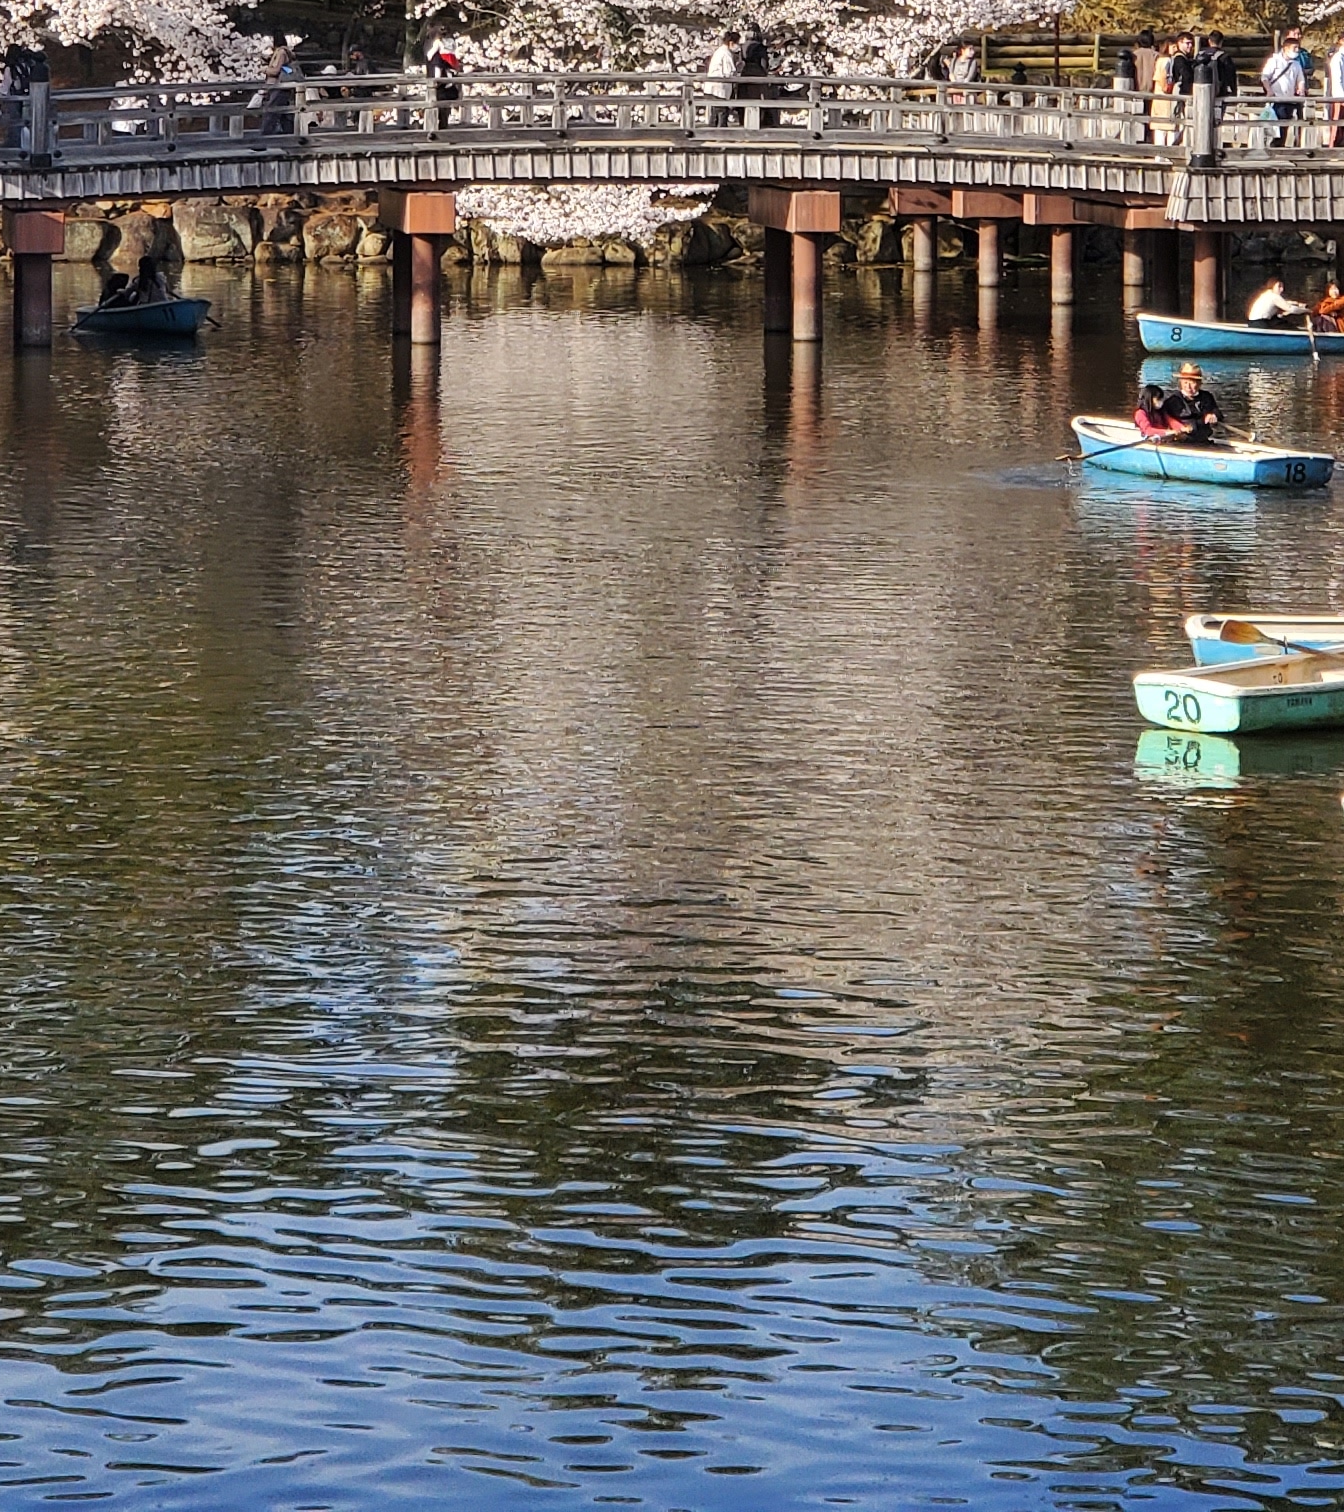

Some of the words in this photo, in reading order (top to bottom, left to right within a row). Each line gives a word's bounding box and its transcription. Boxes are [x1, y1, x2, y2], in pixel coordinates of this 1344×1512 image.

[1170, 327, 1182, 342] 8
[1284, 462, 1306, 483] 18
[1164, 690, 1201, 724] 20
